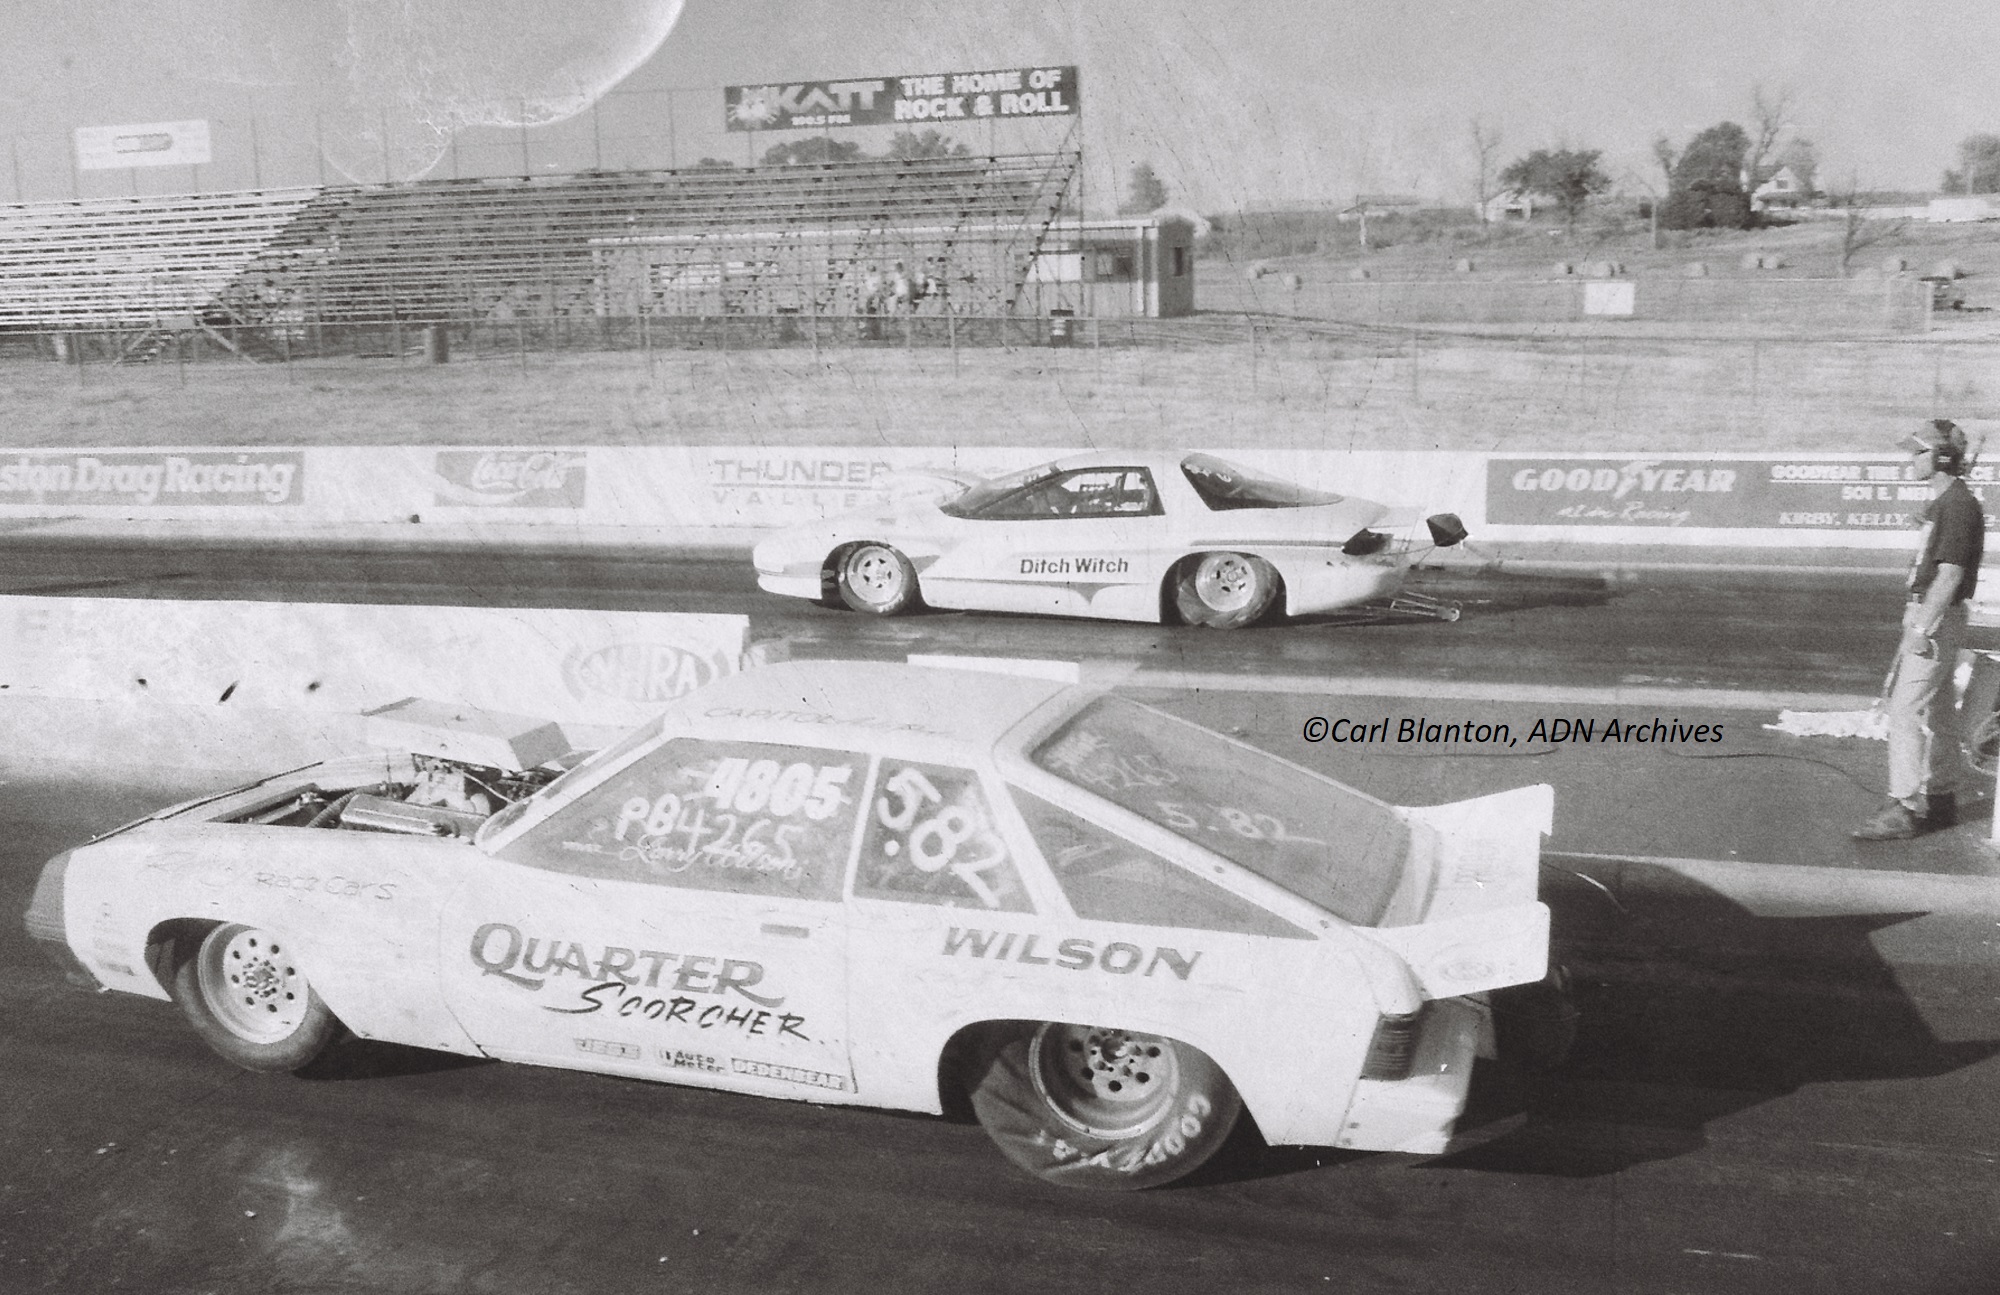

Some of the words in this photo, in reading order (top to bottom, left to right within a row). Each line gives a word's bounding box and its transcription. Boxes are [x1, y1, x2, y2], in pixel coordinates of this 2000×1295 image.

[775, 80, 885, 112] KATT
[900, 75, 945, 96] THE
[952, 72, 1021, 94] HOME
[1029, 70, 1062, 89] OF
[894, 97, 965, 120] ROCK
[973, 95, 994, 116] &
[1000, 91, 1069, 115] ROLL
[77, 457, 160, 501] Drag
[165, 454, 296, 503] Racing
[1512, 466, 1737, 493] GOODYEAR
[1771, 465, 1861, 480] GOODYEAR
[1020, 558, 1070, 574] Ditch
[1076, 557, 1129, 573] Witch
[469, 922, 786, 1008] QUARTER
[942, 927, 1203, 981] WILSON
[541, 981, 811, 1043] SCORCHER
